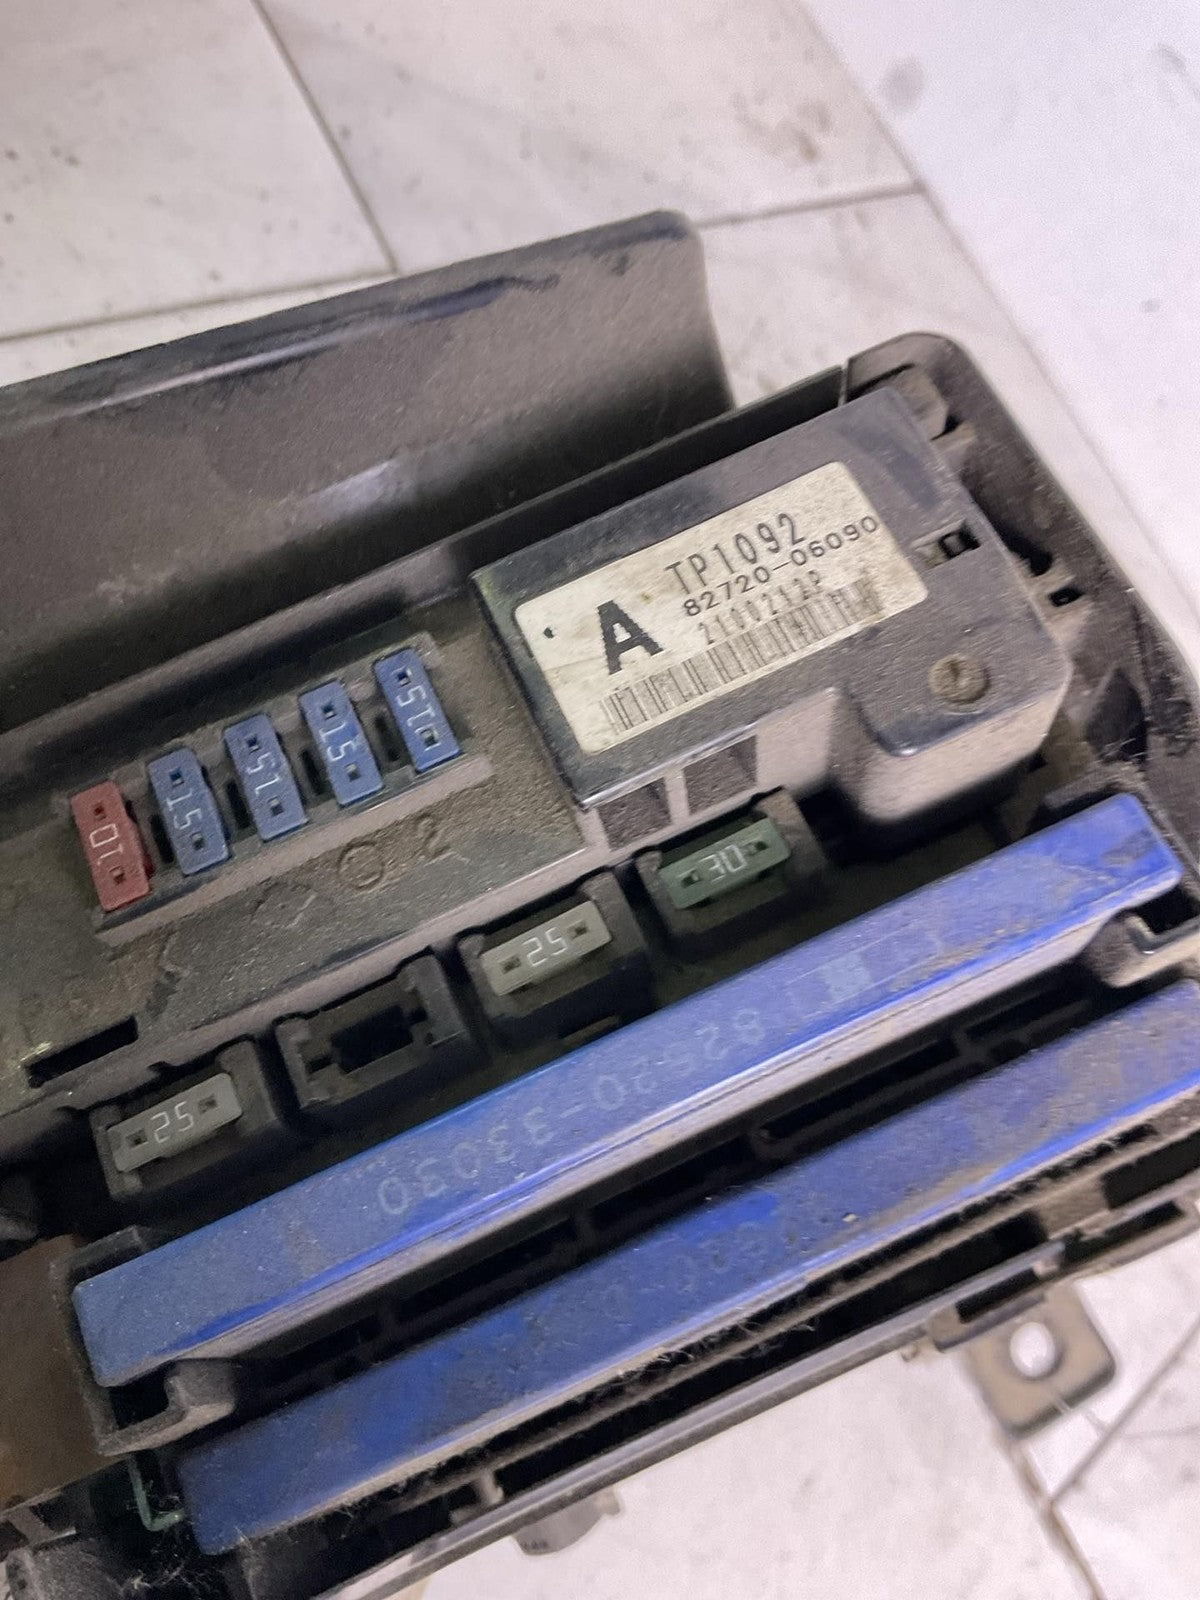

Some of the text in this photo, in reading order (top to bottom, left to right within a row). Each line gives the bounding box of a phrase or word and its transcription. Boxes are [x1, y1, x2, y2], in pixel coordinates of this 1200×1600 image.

[664, 513, 806, 595] TP1092
[683, 515, 878, 616] 82720-06090
[597, 600, 664, 676] A
[318, 721, 358, 761] 15
[245, 751, 281, 795] 15
[165, 787, 203, 831] 15
[89, 823, 124, 866] 10
[699, 843, 748, 884] 30
[521, 926, 568, 968] 25
[150, 1100, 195, 1144] 25
